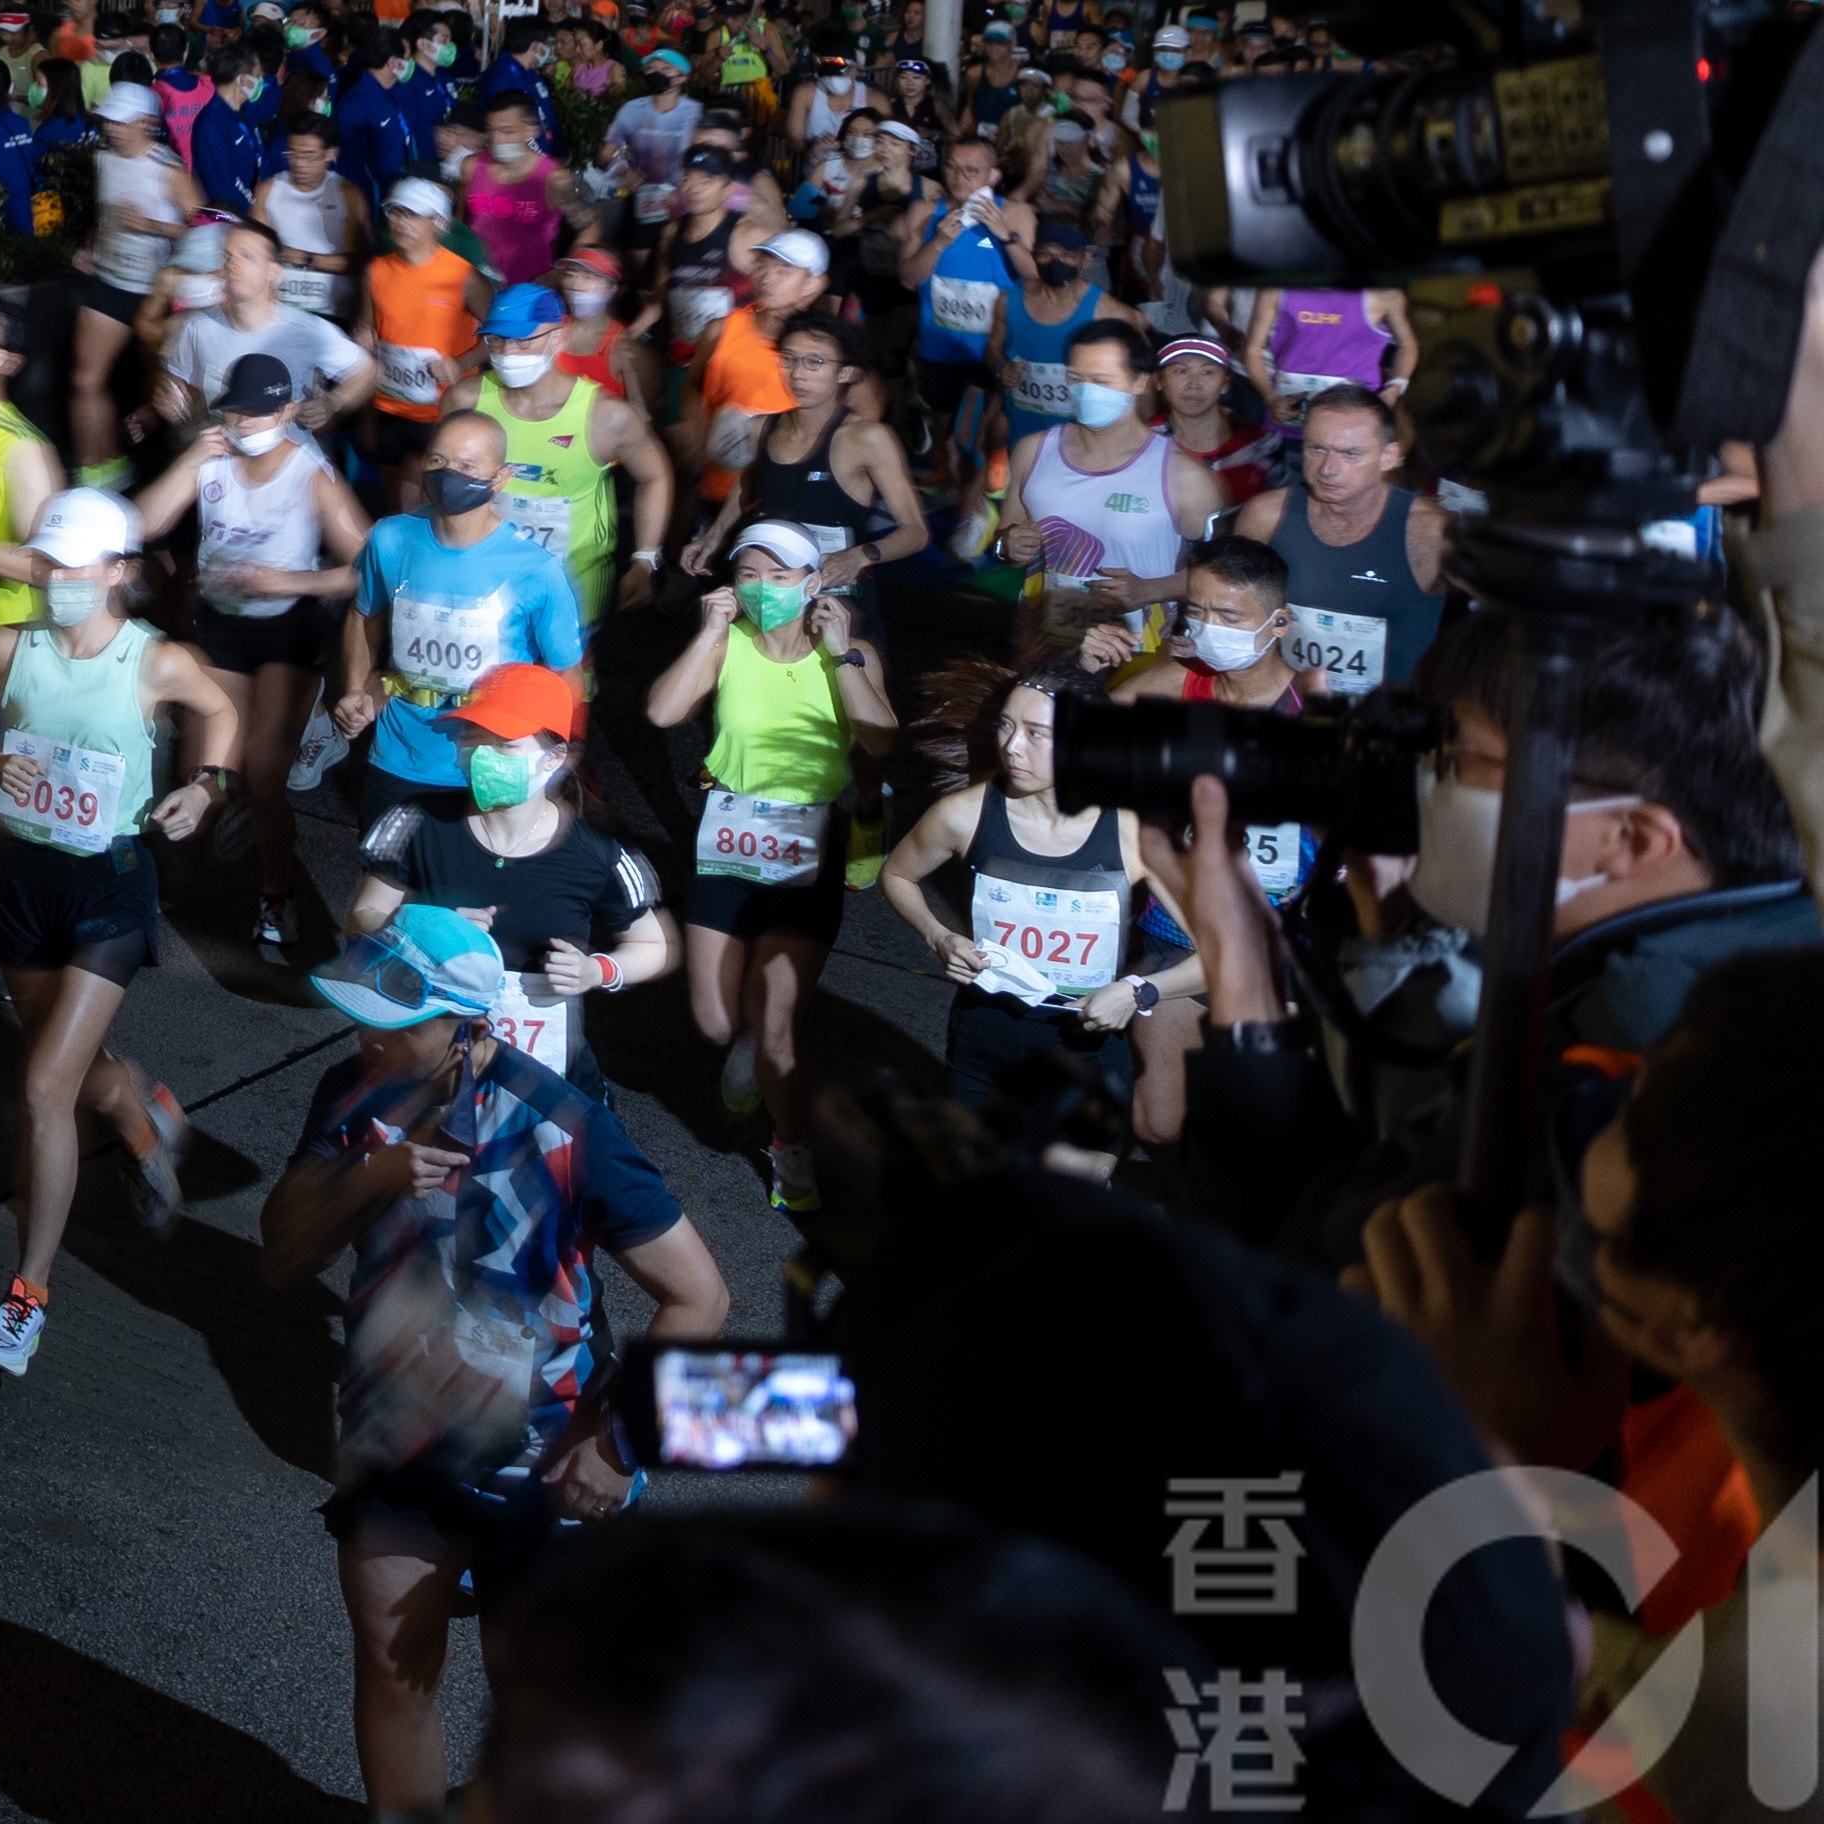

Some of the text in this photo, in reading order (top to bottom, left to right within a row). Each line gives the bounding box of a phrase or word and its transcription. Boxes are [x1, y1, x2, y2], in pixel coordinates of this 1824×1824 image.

[1297, 310, 1343, 326] CUHK
[1017, 378, 1070, 403] 4033
[407, 636, 482, 672] 4009
[1292, 637, 1368, 676] 4024
[716, 826, 804, 867] 8034
[994, 919, 1099, 966] 7027
